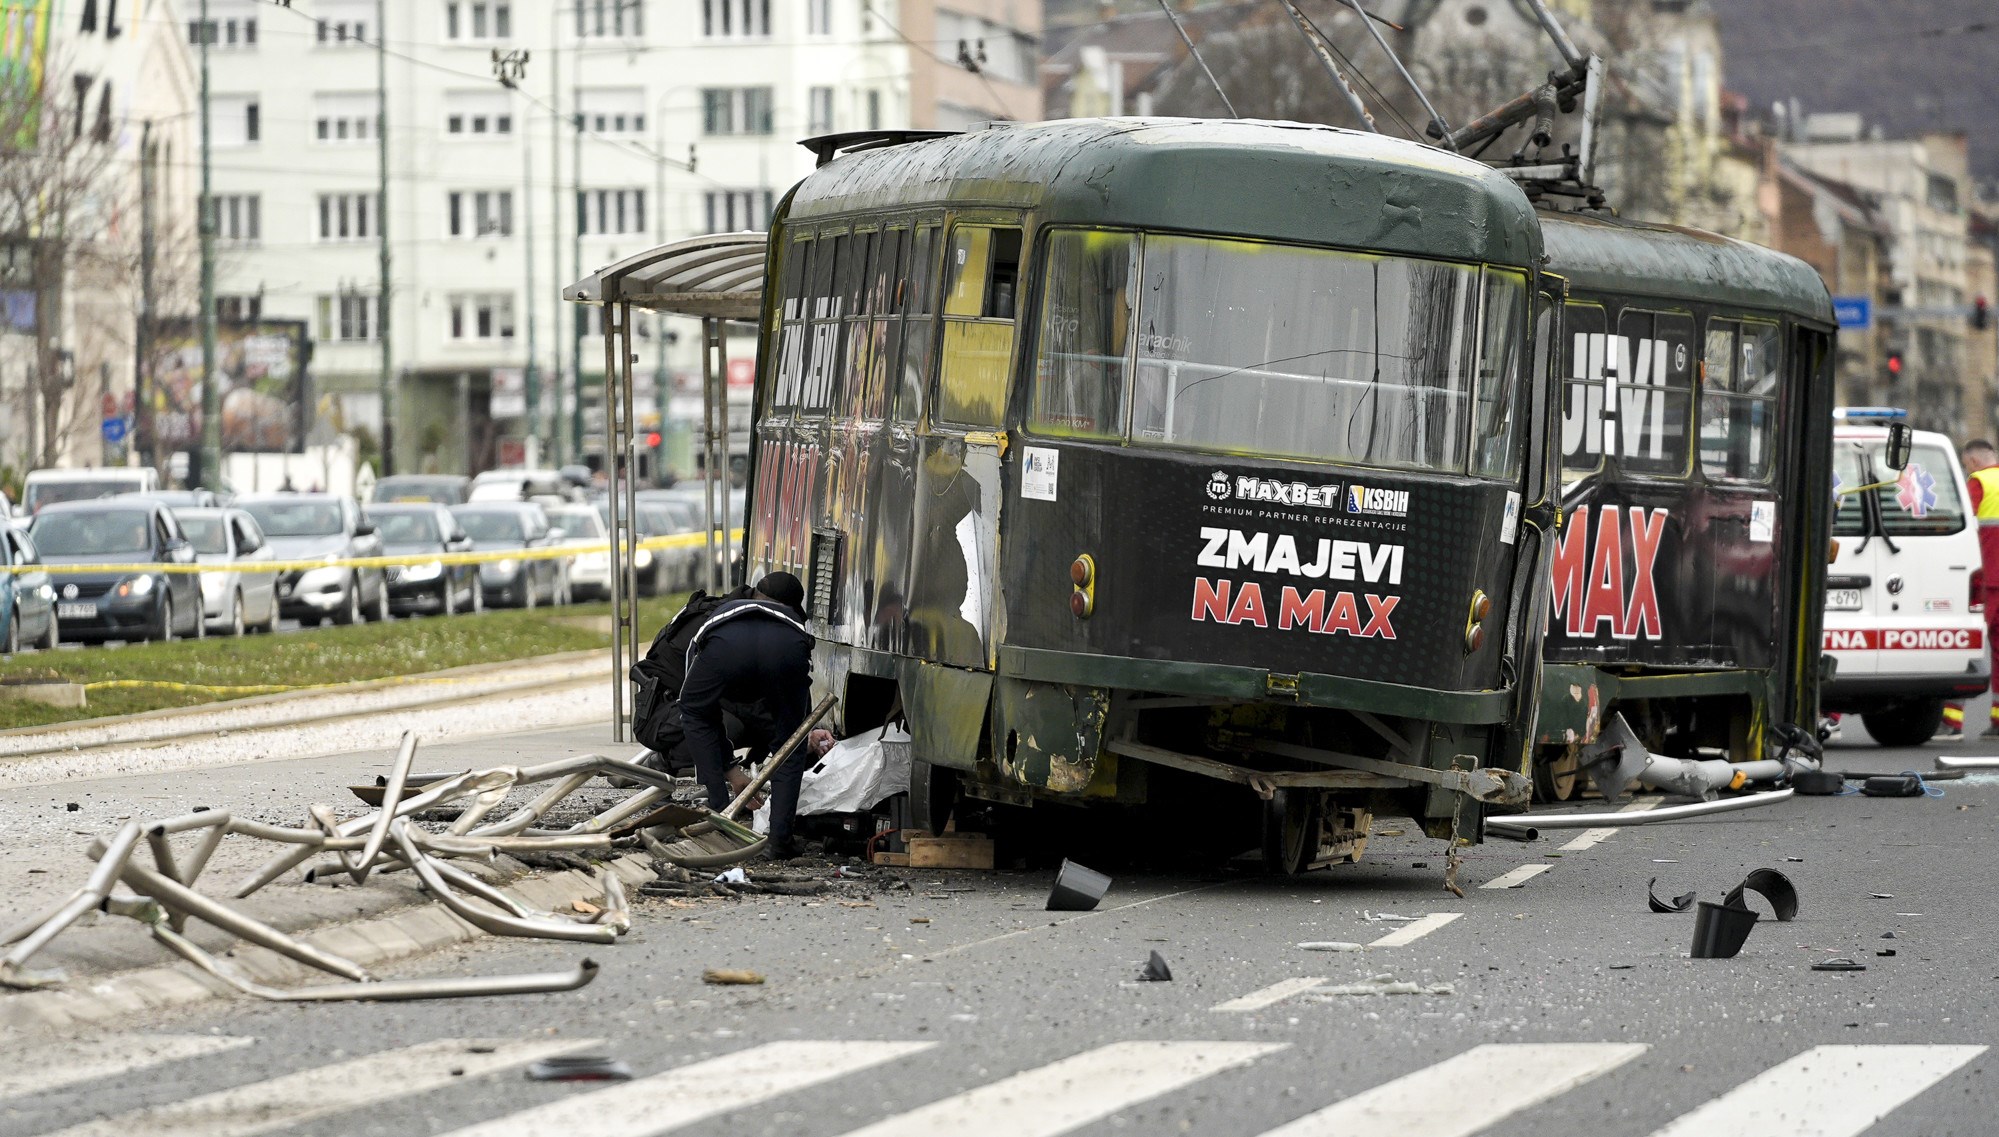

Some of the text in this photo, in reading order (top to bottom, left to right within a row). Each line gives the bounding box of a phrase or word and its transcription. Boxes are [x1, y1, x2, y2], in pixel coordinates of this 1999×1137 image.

[1202, 505, 1407, 531] PREMIUM PARTNER REPREZENTACIJE
[1363, 488, 1409, 512] KSBIH
[1197, 526, 1405, 585] ZMAJEVI
[1545, 504, 1669, 640] MAX
[1191, 576, 1401, 640] NA MAX
